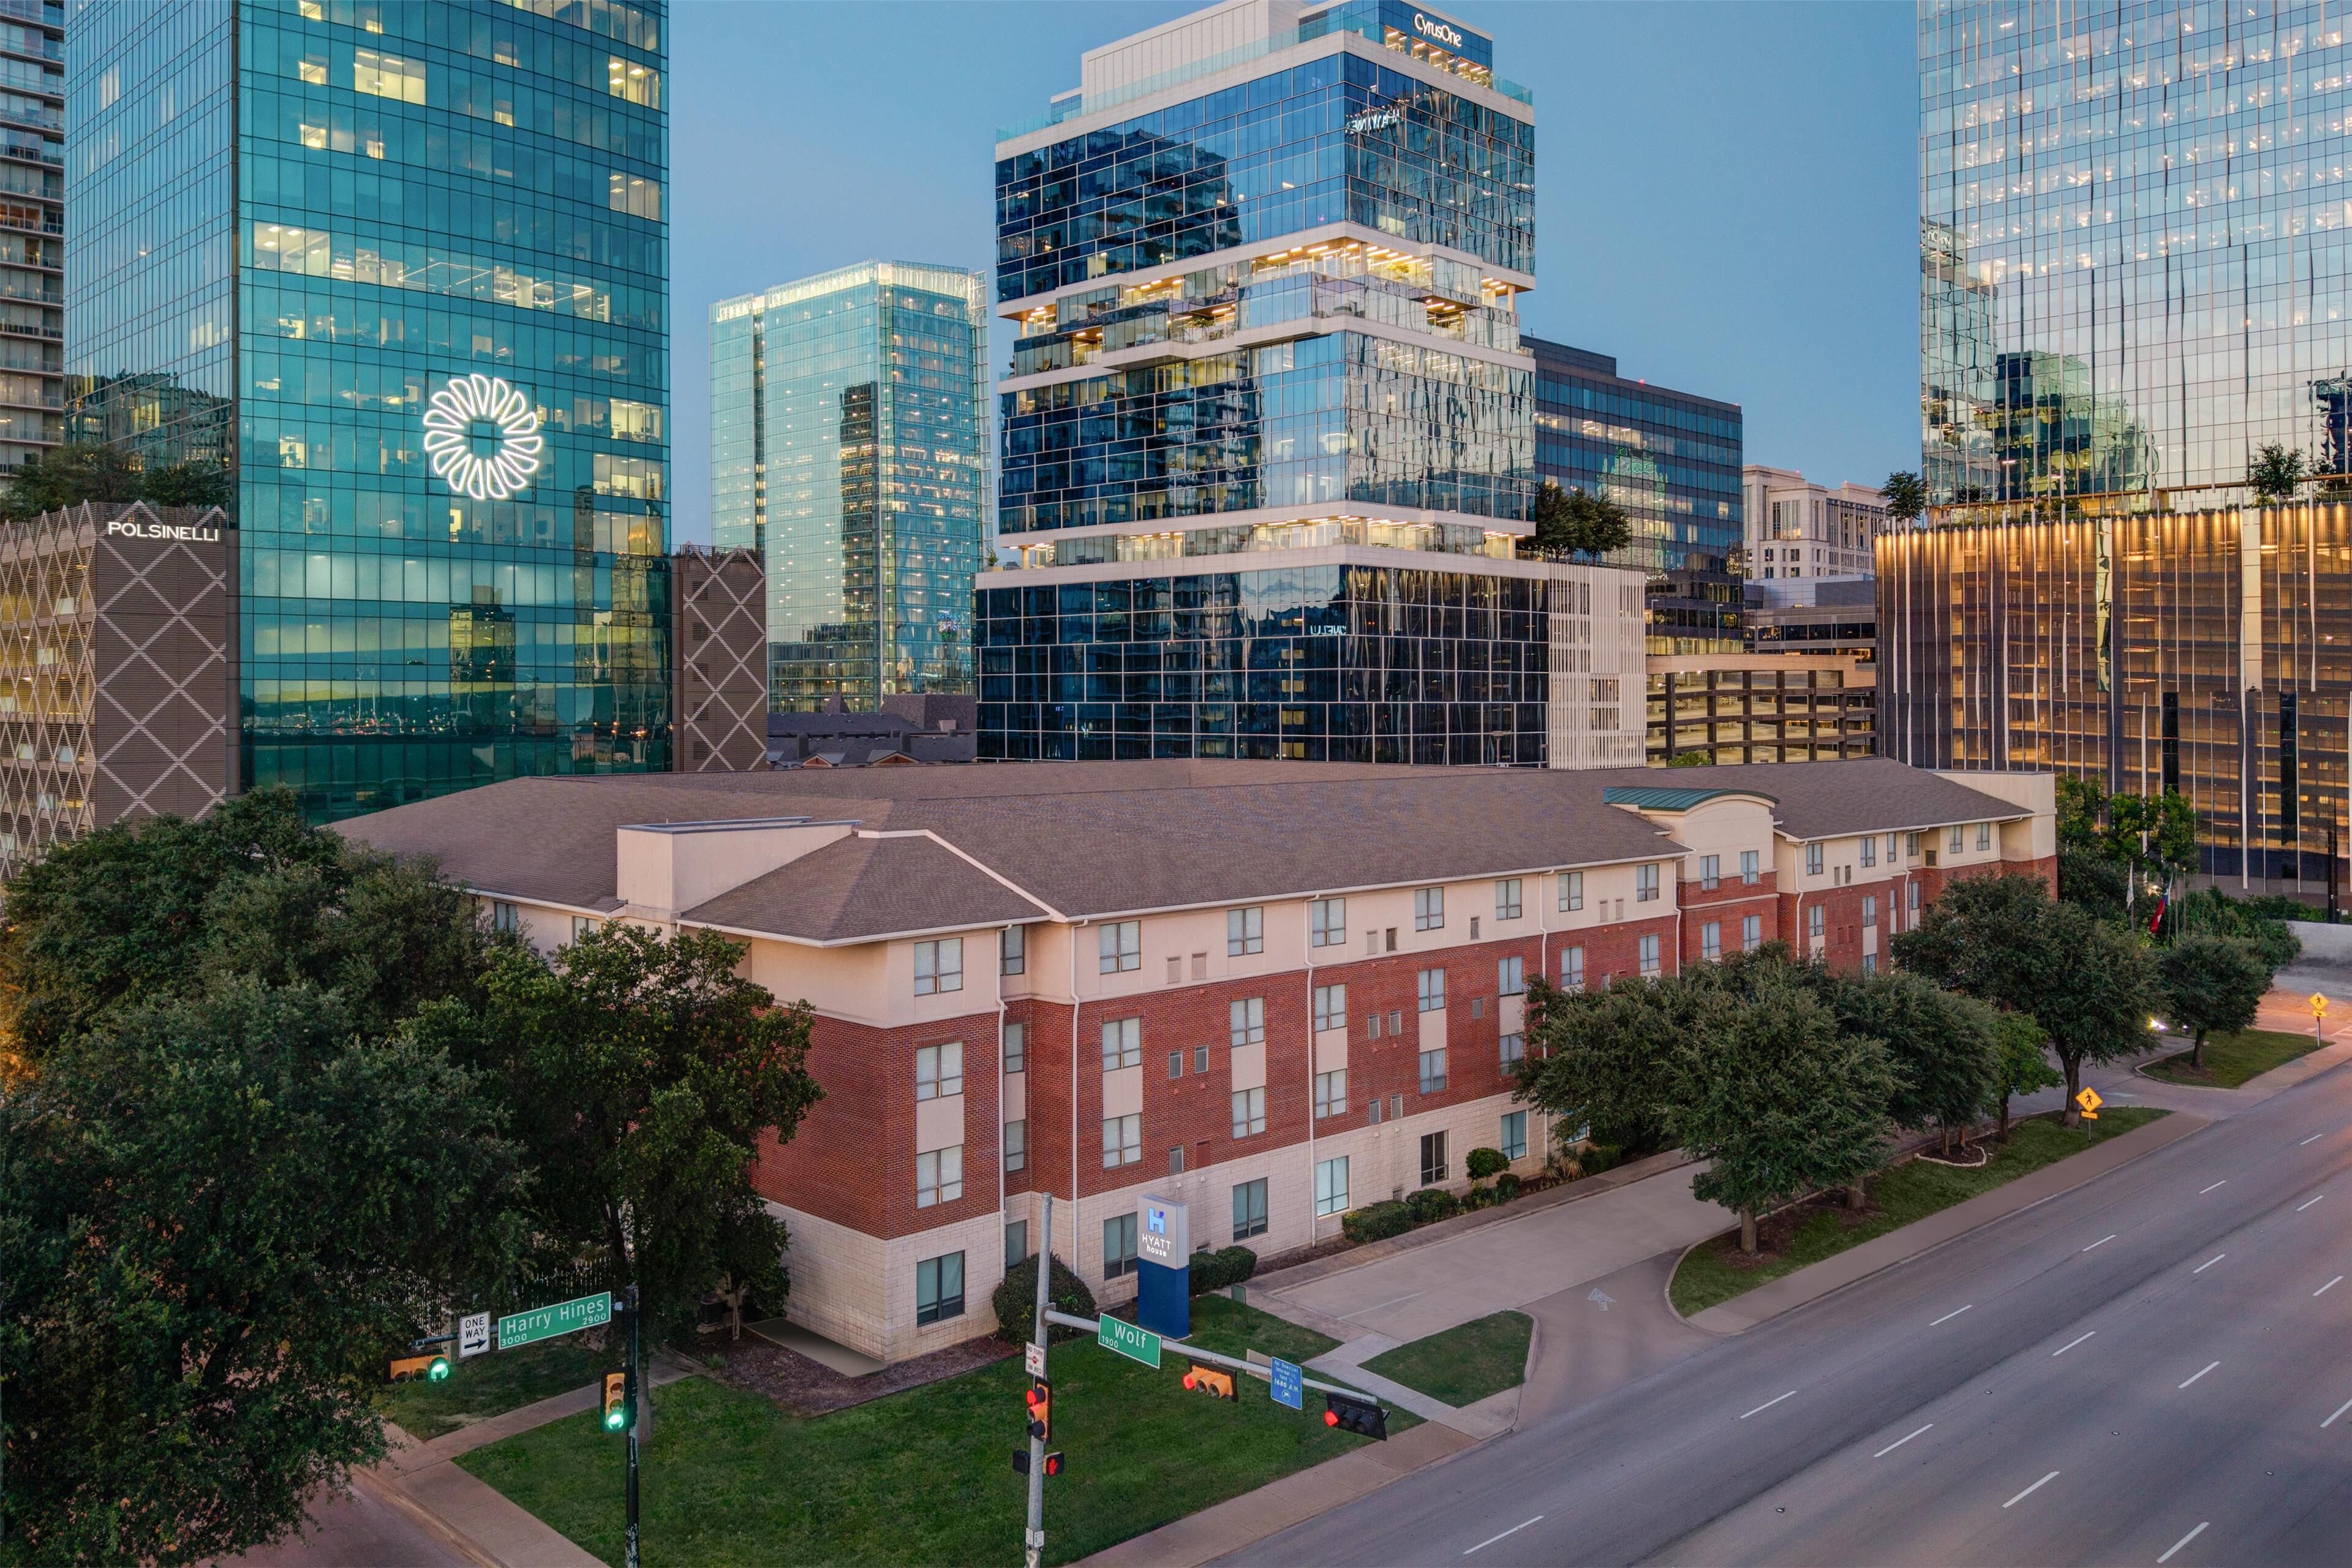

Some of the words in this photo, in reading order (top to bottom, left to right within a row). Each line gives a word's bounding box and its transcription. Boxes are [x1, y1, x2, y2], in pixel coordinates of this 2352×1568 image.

[1414, 13, 1461, 47] CyrusOne
[108, 521, 219, 541] POLSINELLI
[1142, 1233, 1171, 1250] HYATT
[1147, 1244, 1167, 1257] house
[466, 1316, 484, 1329] ONE
[507, 1312, 551, 1335] Harry
[560, 1299, 604, 1320] Hines
[582, 1313, 606, 1325] 2900
[466, 1326, 485, 1339] WAY
[1115, 1322, 1147, 1348] Wolf
[501, 1333, 527, 1346] 3000
[1101, 1335, 1118, 1348] 1900
